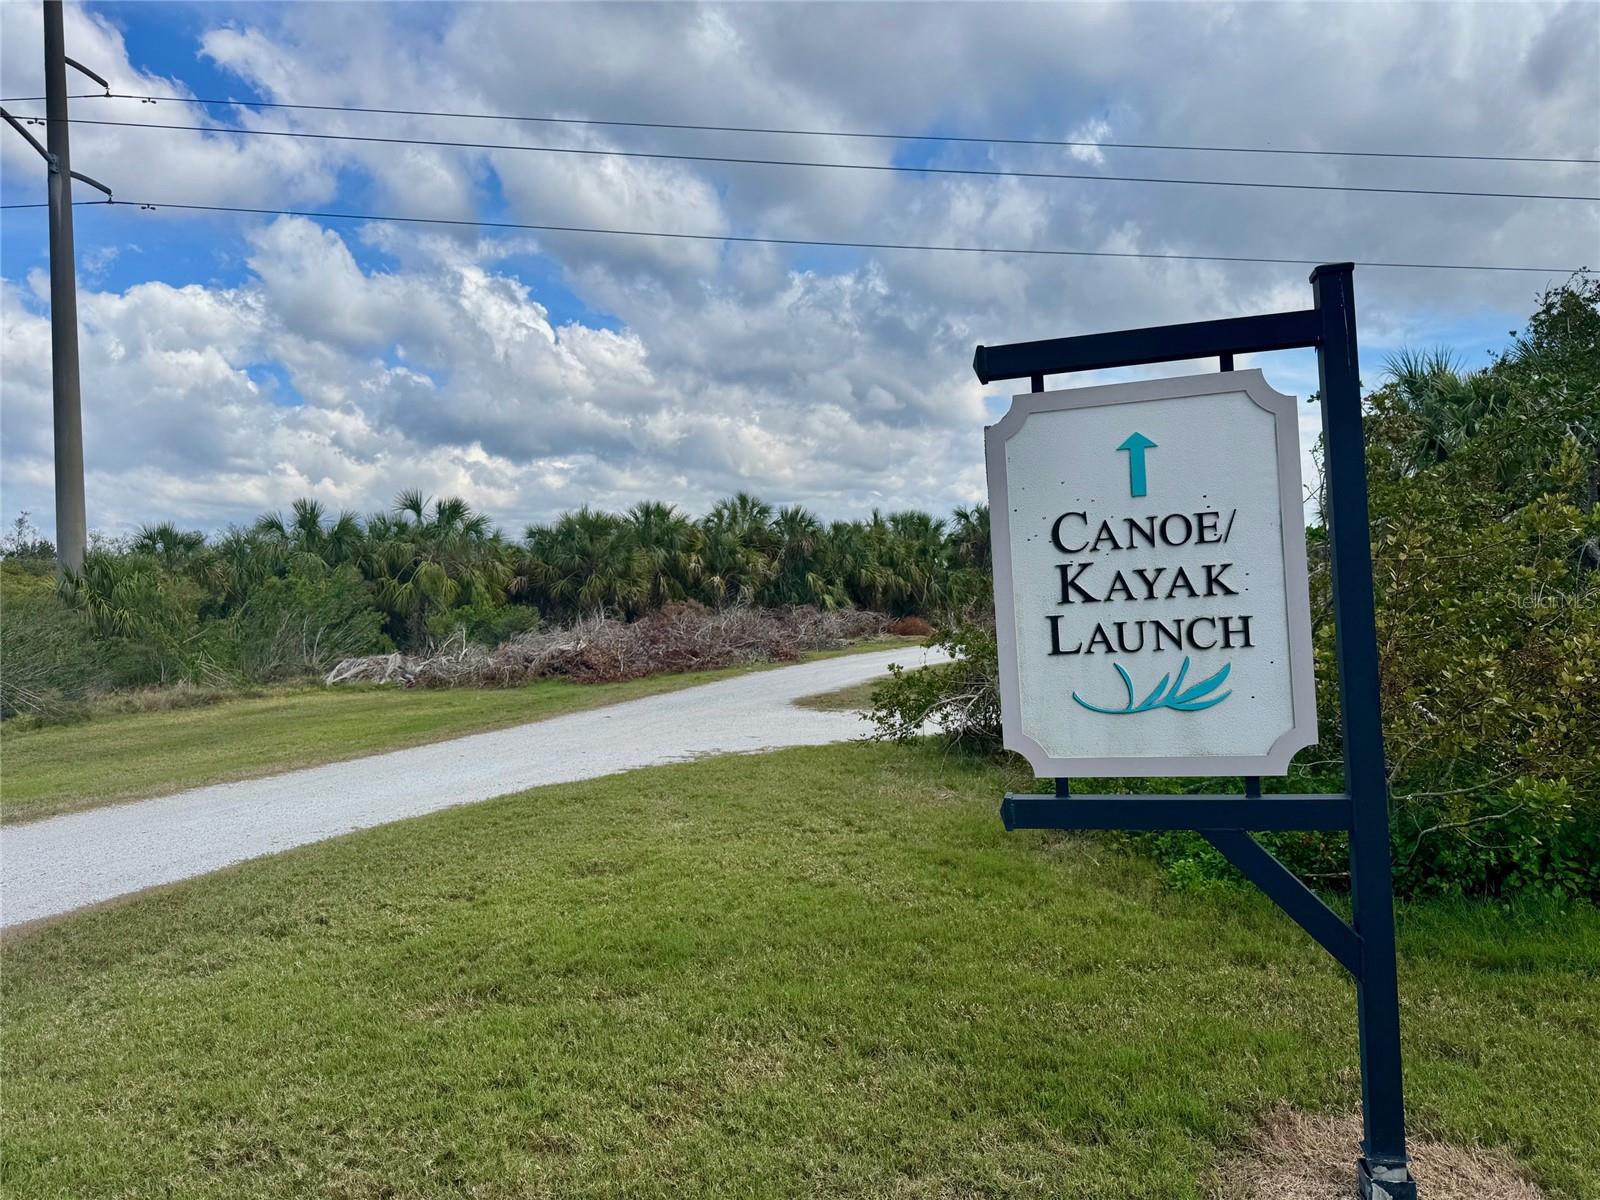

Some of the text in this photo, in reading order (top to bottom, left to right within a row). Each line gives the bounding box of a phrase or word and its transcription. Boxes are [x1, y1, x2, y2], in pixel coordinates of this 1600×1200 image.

[1051, 508, 1237, 554] CANOE/
[1054, 561, 1240, 606] KAYAK
[1045, 614, 1255, 656] LAUNCH
